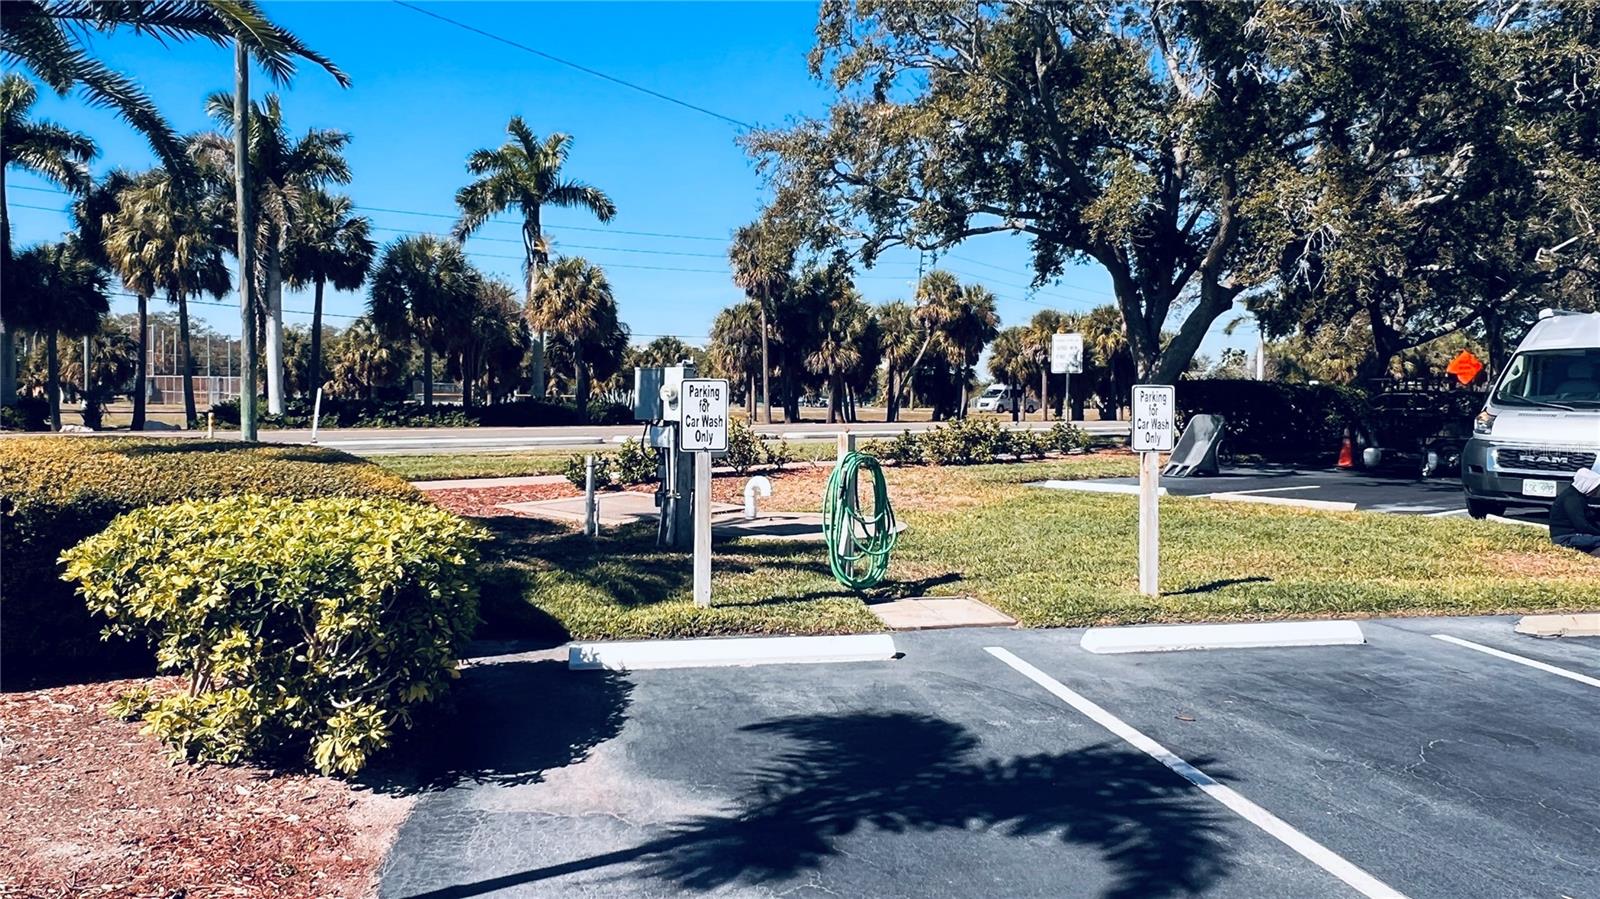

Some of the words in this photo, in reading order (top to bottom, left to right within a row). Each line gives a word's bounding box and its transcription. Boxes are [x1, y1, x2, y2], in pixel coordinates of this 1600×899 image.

[689, 384, 720, 401] Parking
[1140, 390, 1167, 406] Parking
[699, 399, 710, 413] for
[1149, 404, 1159, 416] for
[685, 414, 699, 427] Car
[702, 414, 723, 427] Wash
[1137, 418, 1149, 430] Car
[1151, 418, 1169, 430] Wash
[695, 429, 713, 446] Only
[1145, 431, 1161, 446] Only
[1519, 455, 1568, 464] RAM
